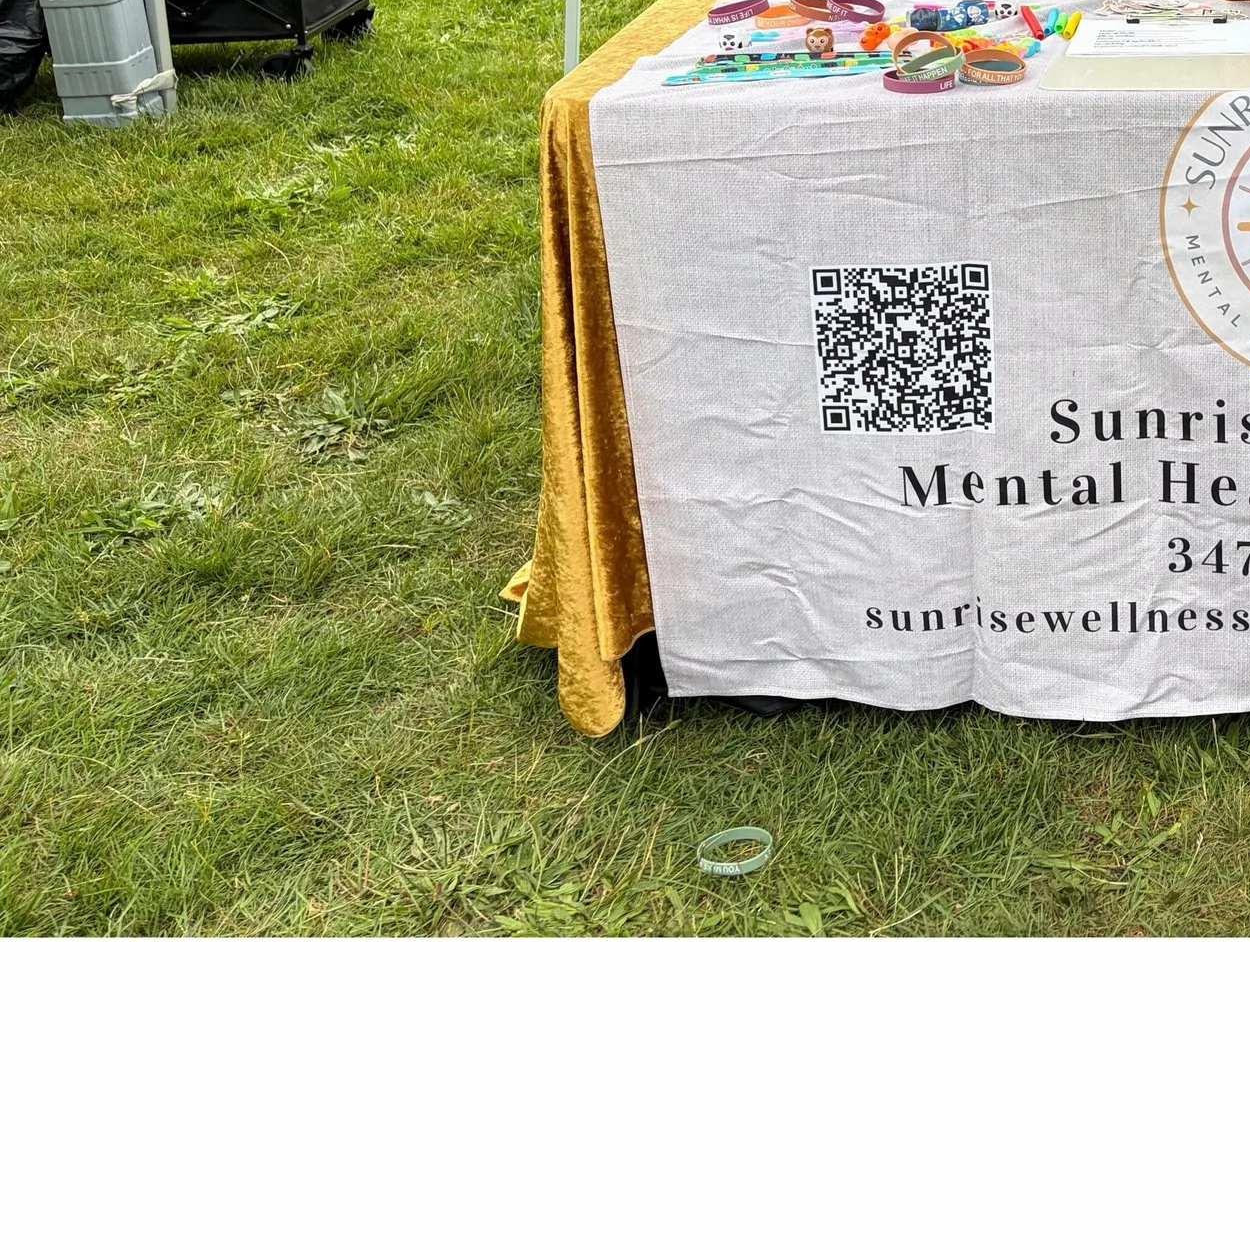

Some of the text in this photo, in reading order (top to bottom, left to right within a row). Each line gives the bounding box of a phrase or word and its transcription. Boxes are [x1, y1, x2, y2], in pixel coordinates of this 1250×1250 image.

[713, 9, 754, 24] LIFE IS WHAT
[832, 7, 841, 15] OF
[920, 67, 948, 80] HAPPEN
[968, 70, 982, 79] FOR
[982, 73, 996, 82] ALL
[997, 74, 1013, 82] THAT
[940, 80, 954, 90] LIFE
[1186, 234, 1242, 328] MENTAL
[899, 461, 1125, 508] Mental
